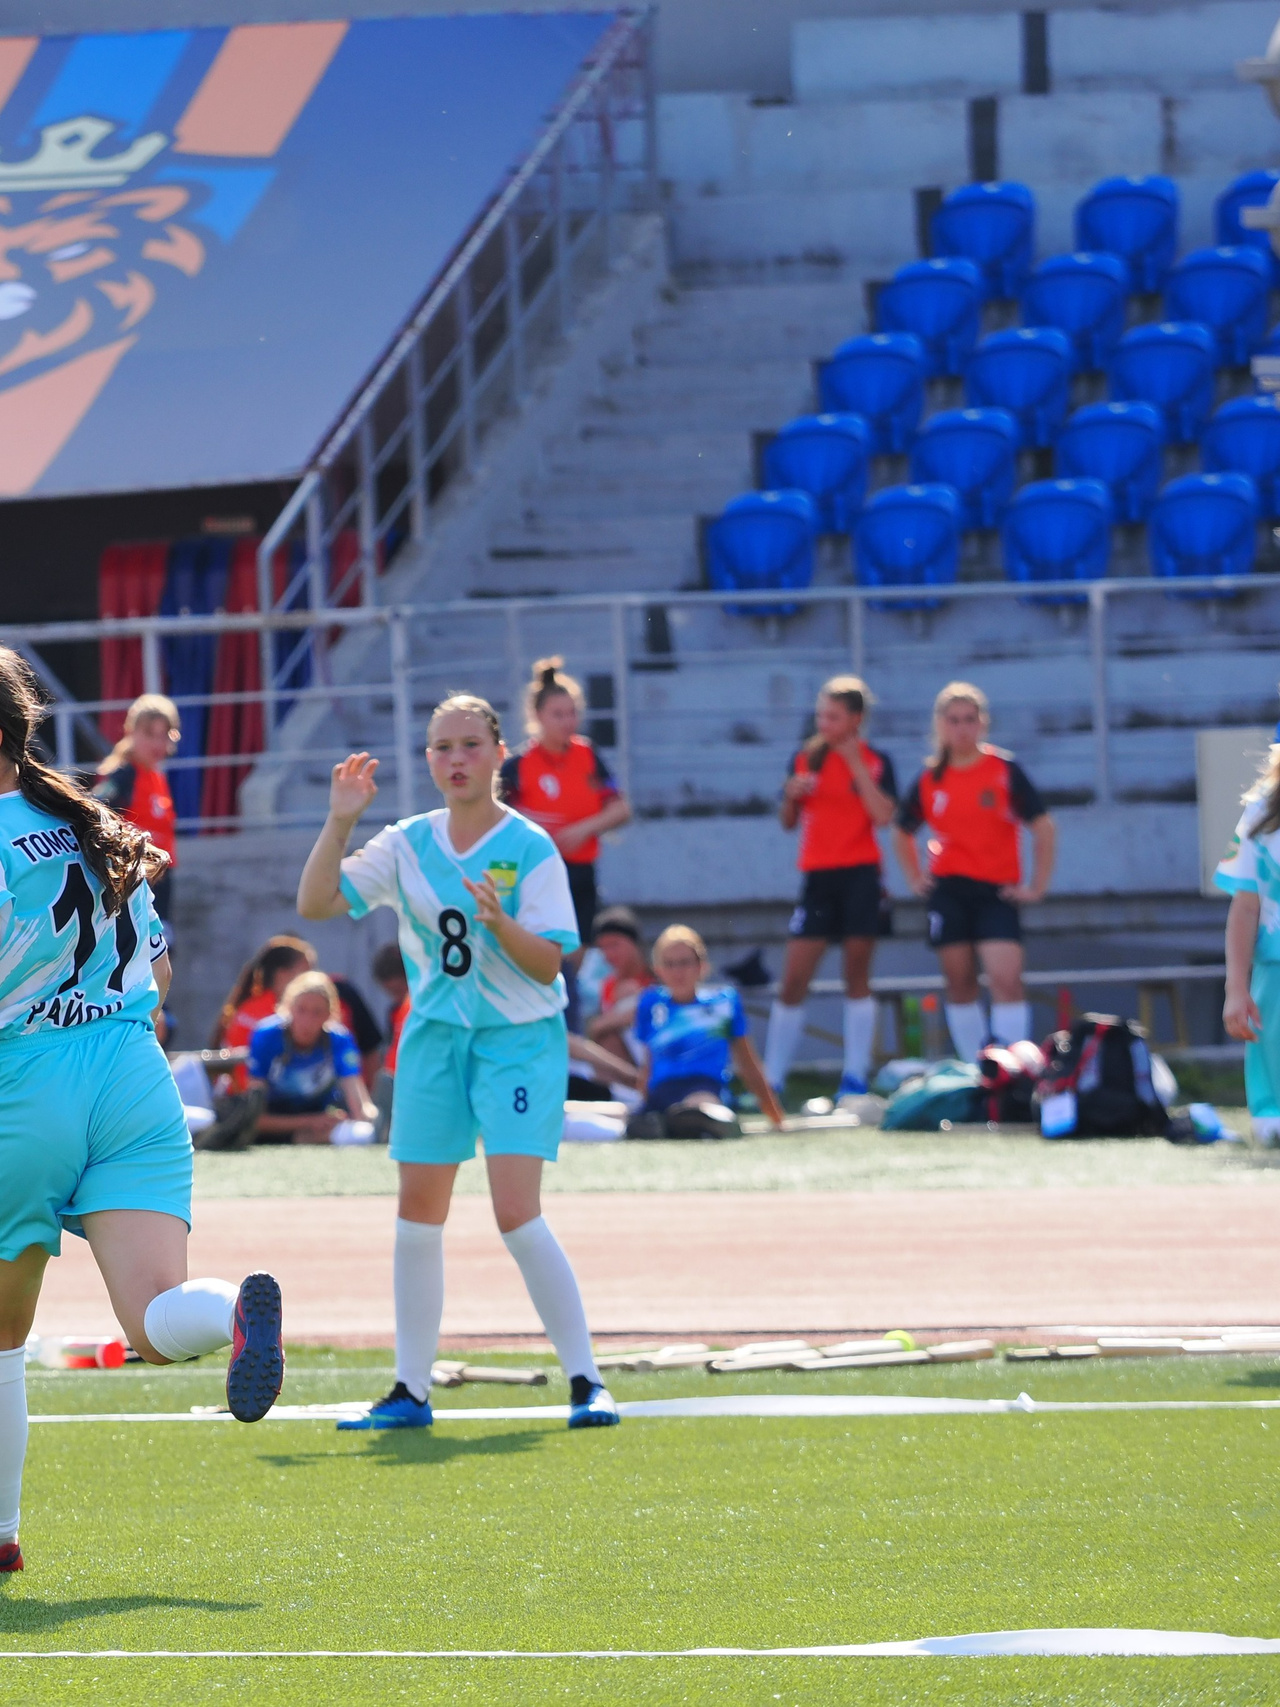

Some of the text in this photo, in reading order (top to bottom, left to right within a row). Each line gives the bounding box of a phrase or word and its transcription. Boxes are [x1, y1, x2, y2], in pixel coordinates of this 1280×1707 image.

[51, 862, 138, 995] 11
[438, 908, 472, 977] 8
[513, 1086, 528, 1114] 8
